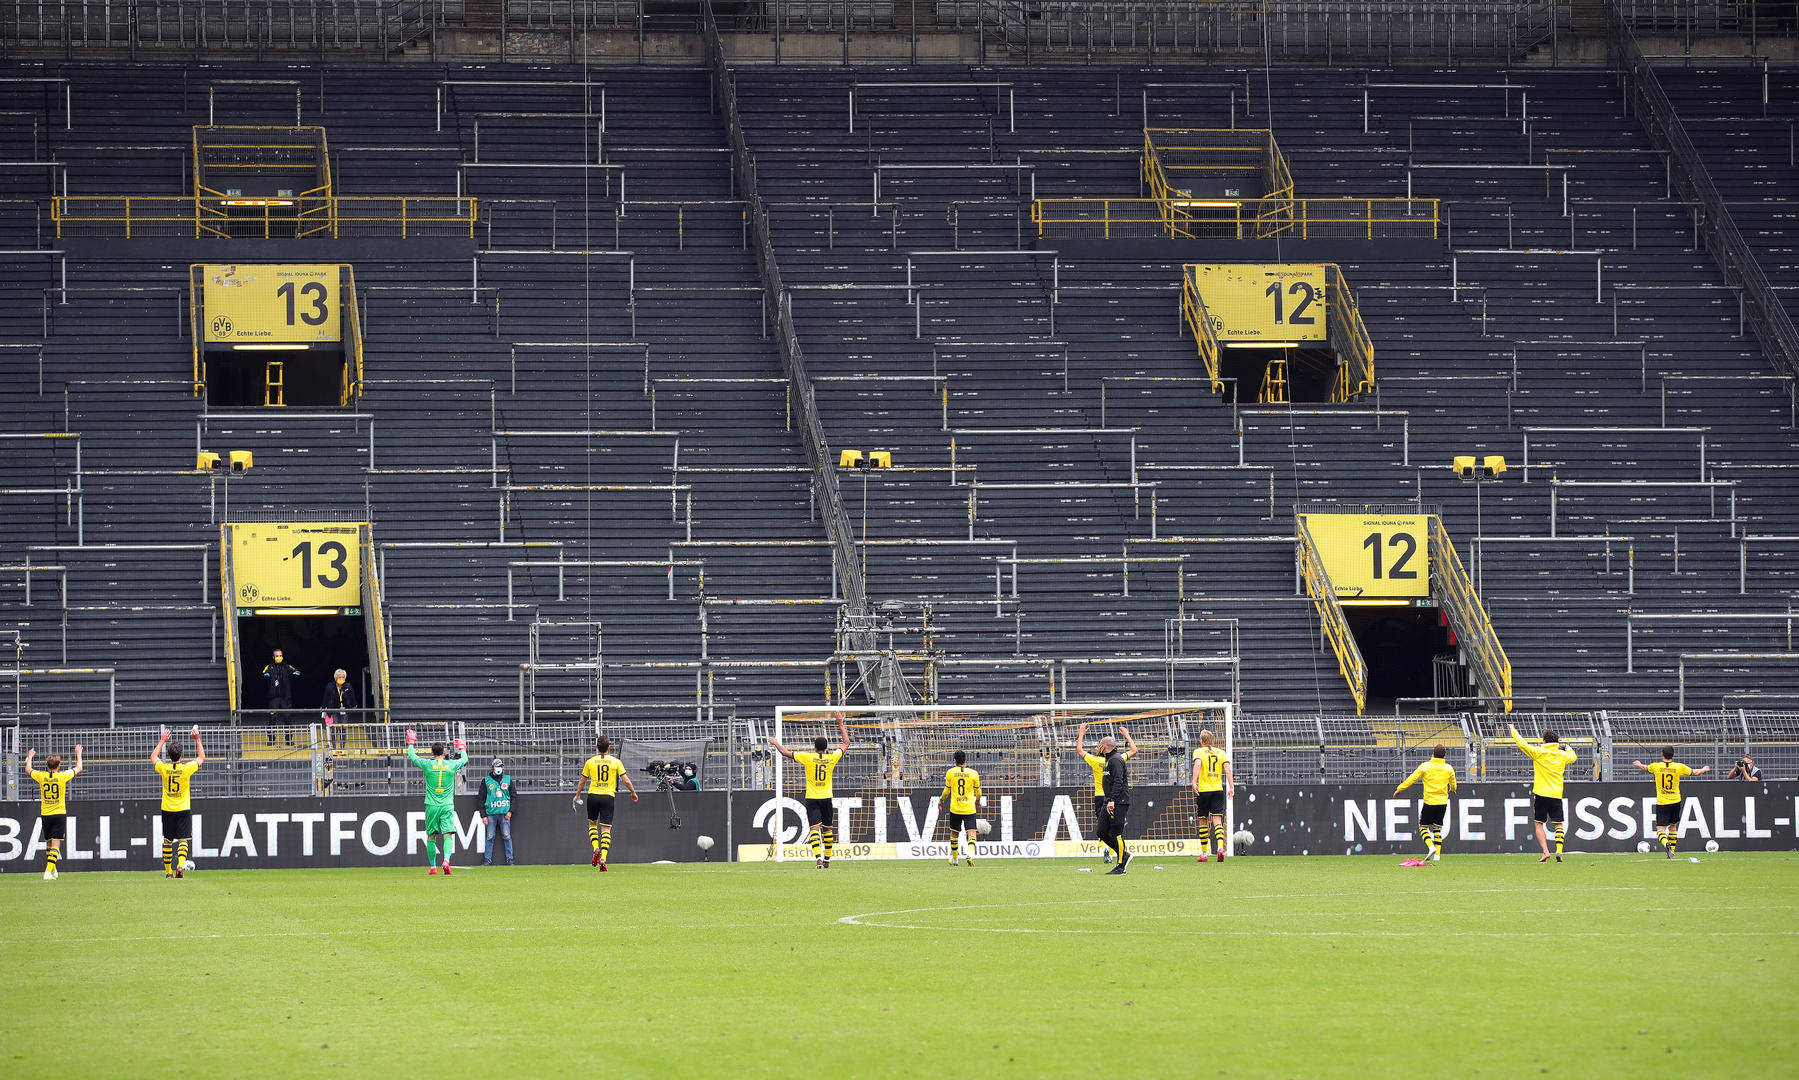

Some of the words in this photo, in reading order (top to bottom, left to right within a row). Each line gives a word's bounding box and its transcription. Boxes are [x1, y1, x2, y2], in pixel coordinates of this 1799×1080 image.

[277, 281, 329, 326] 13
[1265, 281, 1315, 325] 12
[213, 317, 231, 332] BVB
[1363, 532, 1417, 580] 12
[292, 541, 348, 589] 13
[242, 585, 258, 598] BVB
[1208, 755, 1218, 772] 17
[438, 770, 443, 788] 1
[597, 764, 609, 782] 18
[815, 764, 827, 781] 16
[168, 776, 180, 793] 15
[957, 778, 965, 796] 8
[1661, 773, 1674, 790] 13
[43, 783, 59, 800] 29
[490, 800, 509, 809] HOST
